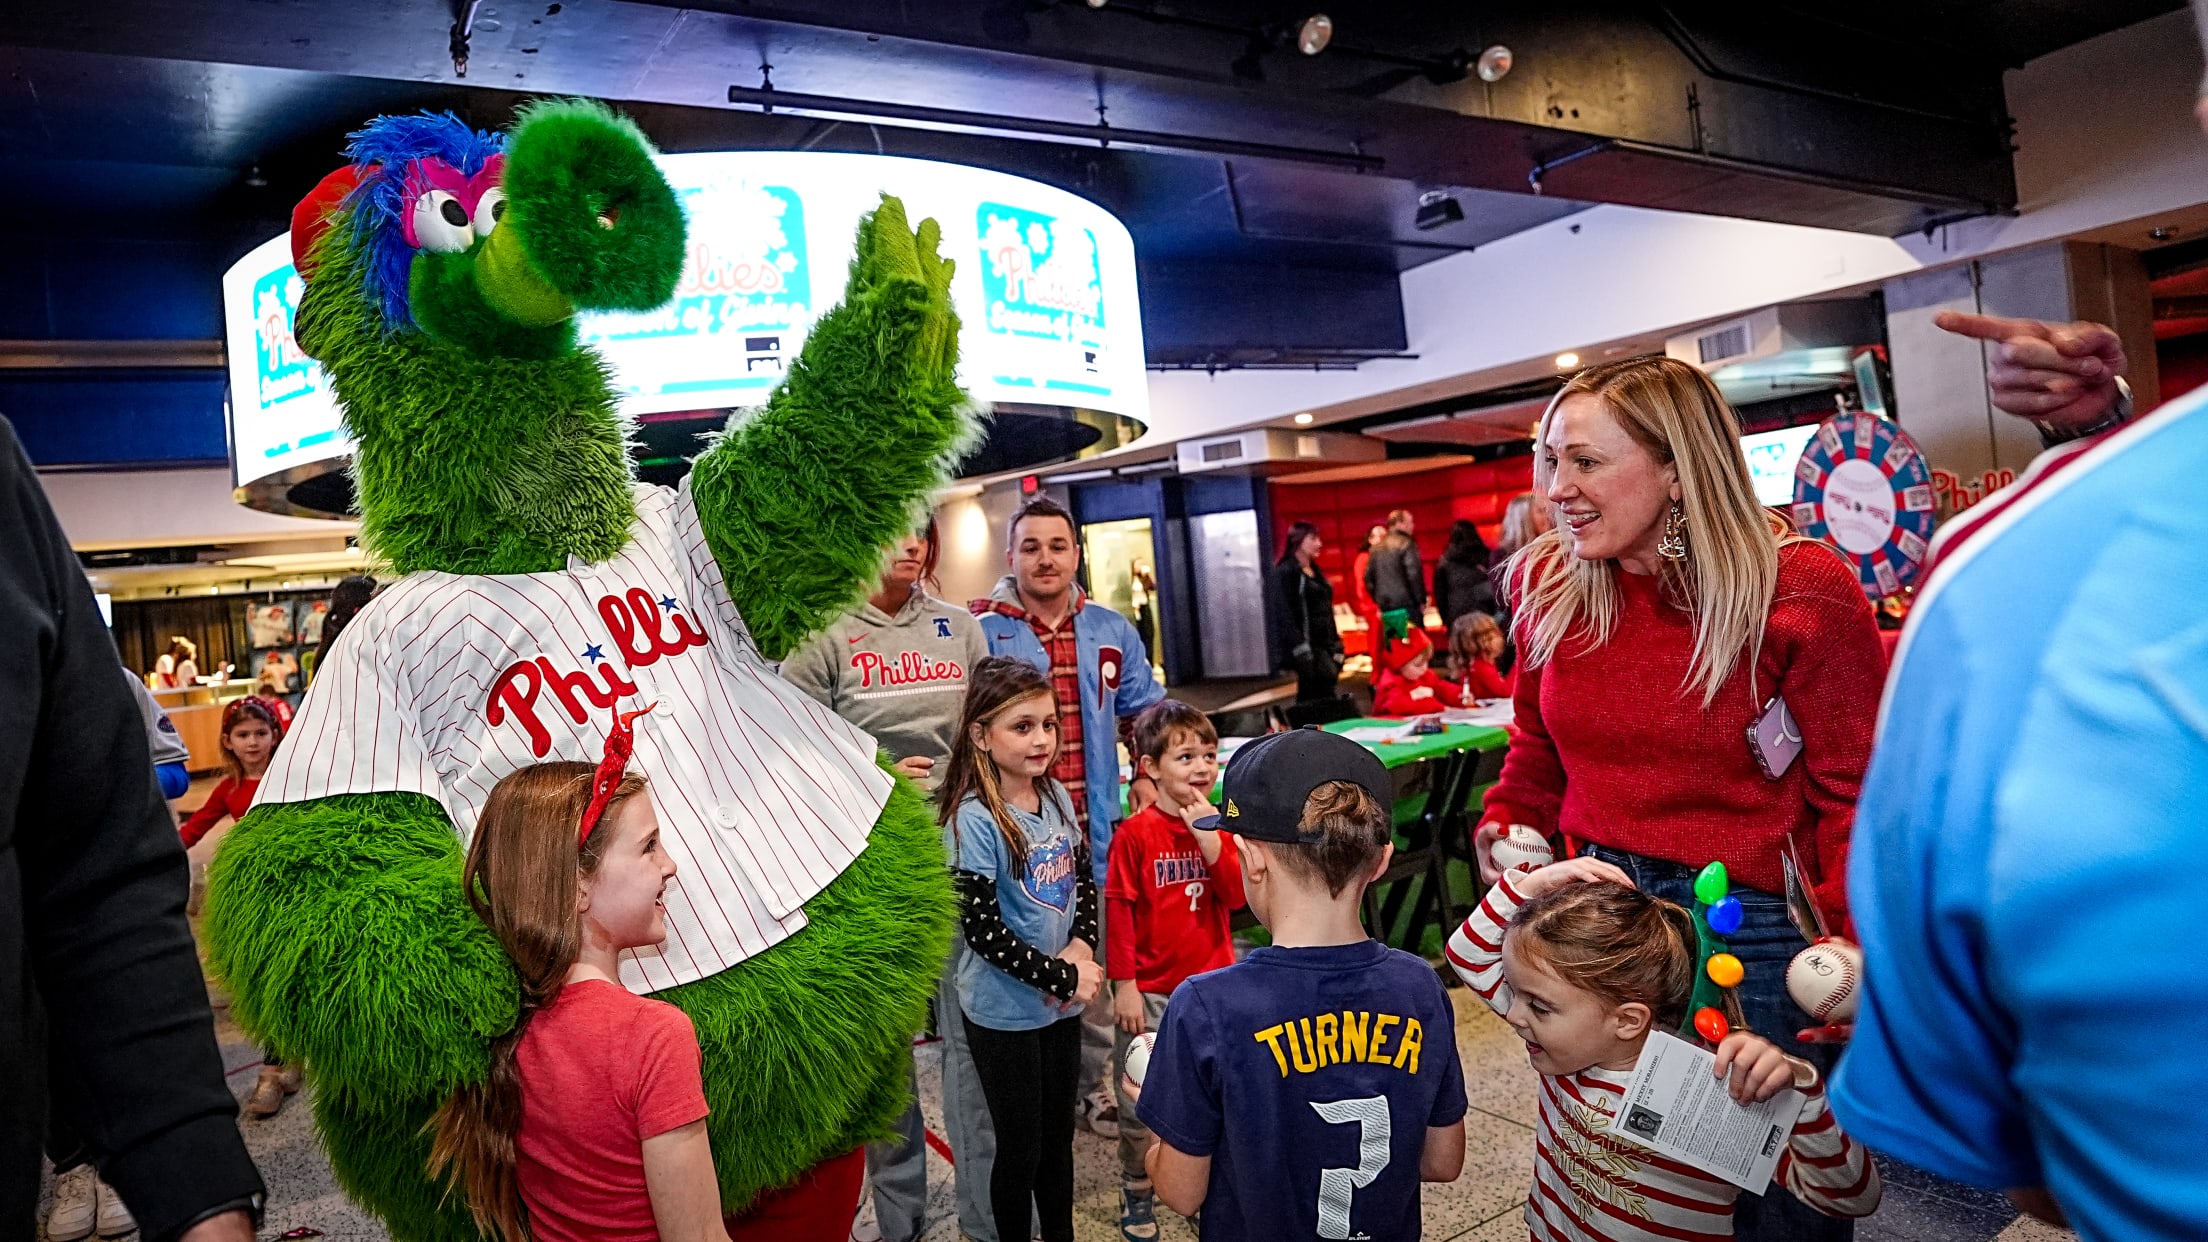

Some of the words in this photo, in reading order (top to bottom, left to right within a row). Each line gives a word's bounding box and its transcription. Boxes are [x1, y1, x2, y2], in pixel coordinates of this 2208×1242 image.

[674, 243, 783, 294] lies
[851, 651, 963, 687] Phillies
[1098, 645, 1123, 711] P
[1153, 857, 1211, 888] PHILL
[1184, 881, 1205, 912] P
[1254, 1010, 1423, 1079] TURNER
[1309, 1094, 1391, 1241] 7
